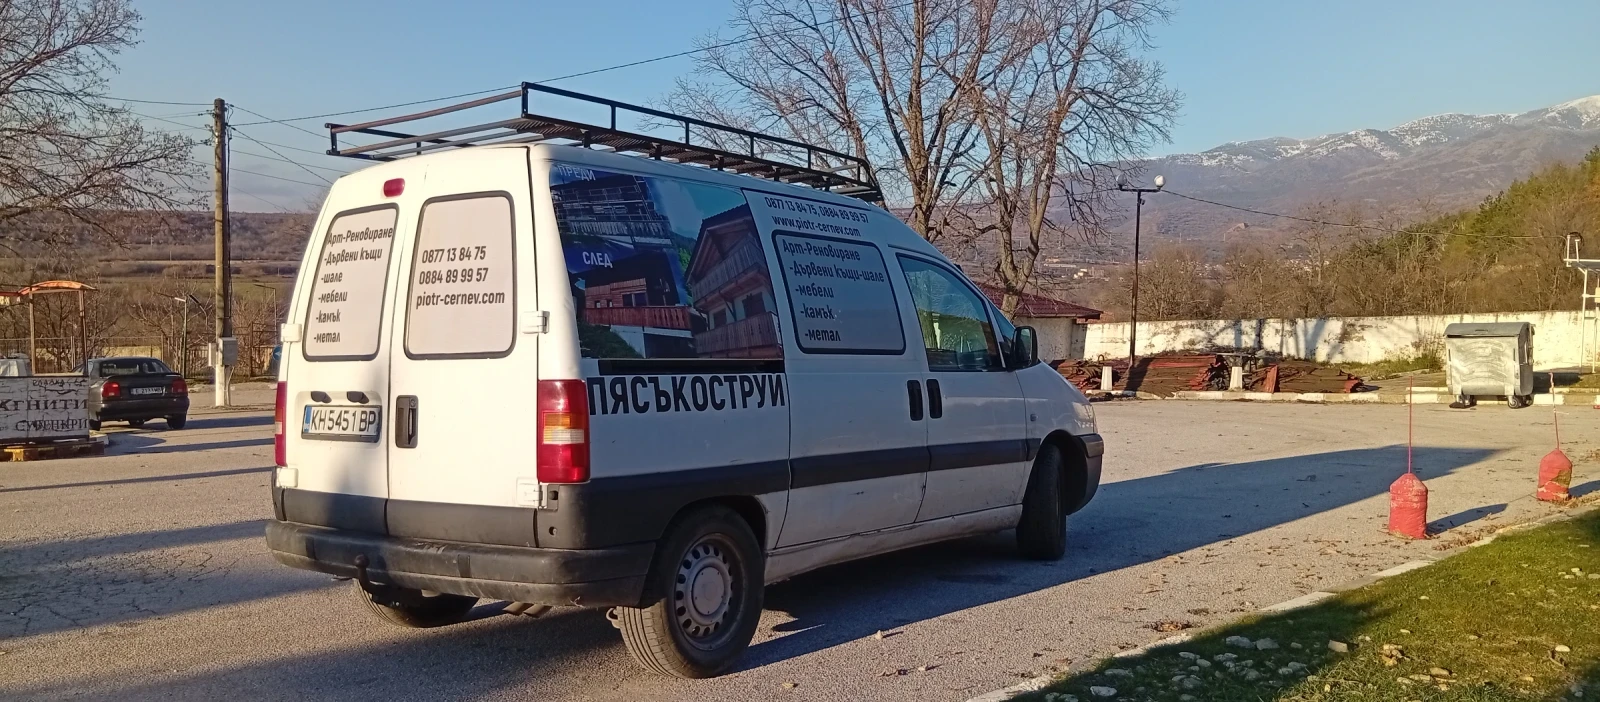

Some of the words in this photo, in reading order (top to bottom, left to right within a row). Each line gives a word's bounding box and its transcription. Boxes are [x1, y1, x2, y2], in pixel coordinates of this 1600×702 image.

[557, 164, 596, 181] ПРЕДИ
[764, 197, 784, 210] 0877
[785, 200, 796, 211] 13
[796, 201, 807, 213] 84
[806, 203, 820, 217] 75,
[819, 206, 839, 219] 0884
[839, 209, 850, 221] 89
[849, 211, 860, 223] 99
[859, 213, 869, 224] 57
[772, 215, 862, 237] www.piotr-cernev.com
[327, 227, 394, 247] Арт-Реновиране
[324, 249, 359, 266] -Дървени
[359, 247, 383, 261] къщи
[422, 249, 445, 263] 0877
[446, 248, 457, 262] 13
[459, 247, 472, 261] 84
[474, 246, 487, 260] 75
[782, 239, 861, 262] Арт-Реновиране
[582, 252, 613, 268] СЛЕД
[321, 272, 343, 283] -шале
[419, 270, 443, 285] 0884
[445, 269, 459, 283] 89
[460, 268, 474, 283] 99
[475, 267, 489, 282] 57
[789, 260, 834, 278] -Дървени
[833, 265, 885, 283] къщи-шале
[318, 290, 348, 304] -мебели
[795, 282, 835, 299] -мебели
[416, 291, 505, 310] piotr-cernev.com
[315, 309, 341, 324] -камък
[800, 302, 835, 320] -камък
[313, 329, 341, 344] -метал
[804, 328, 842, 342] -метал
[327, 409, 357, 432] 5451
[359, 410, 377, 433] BP
